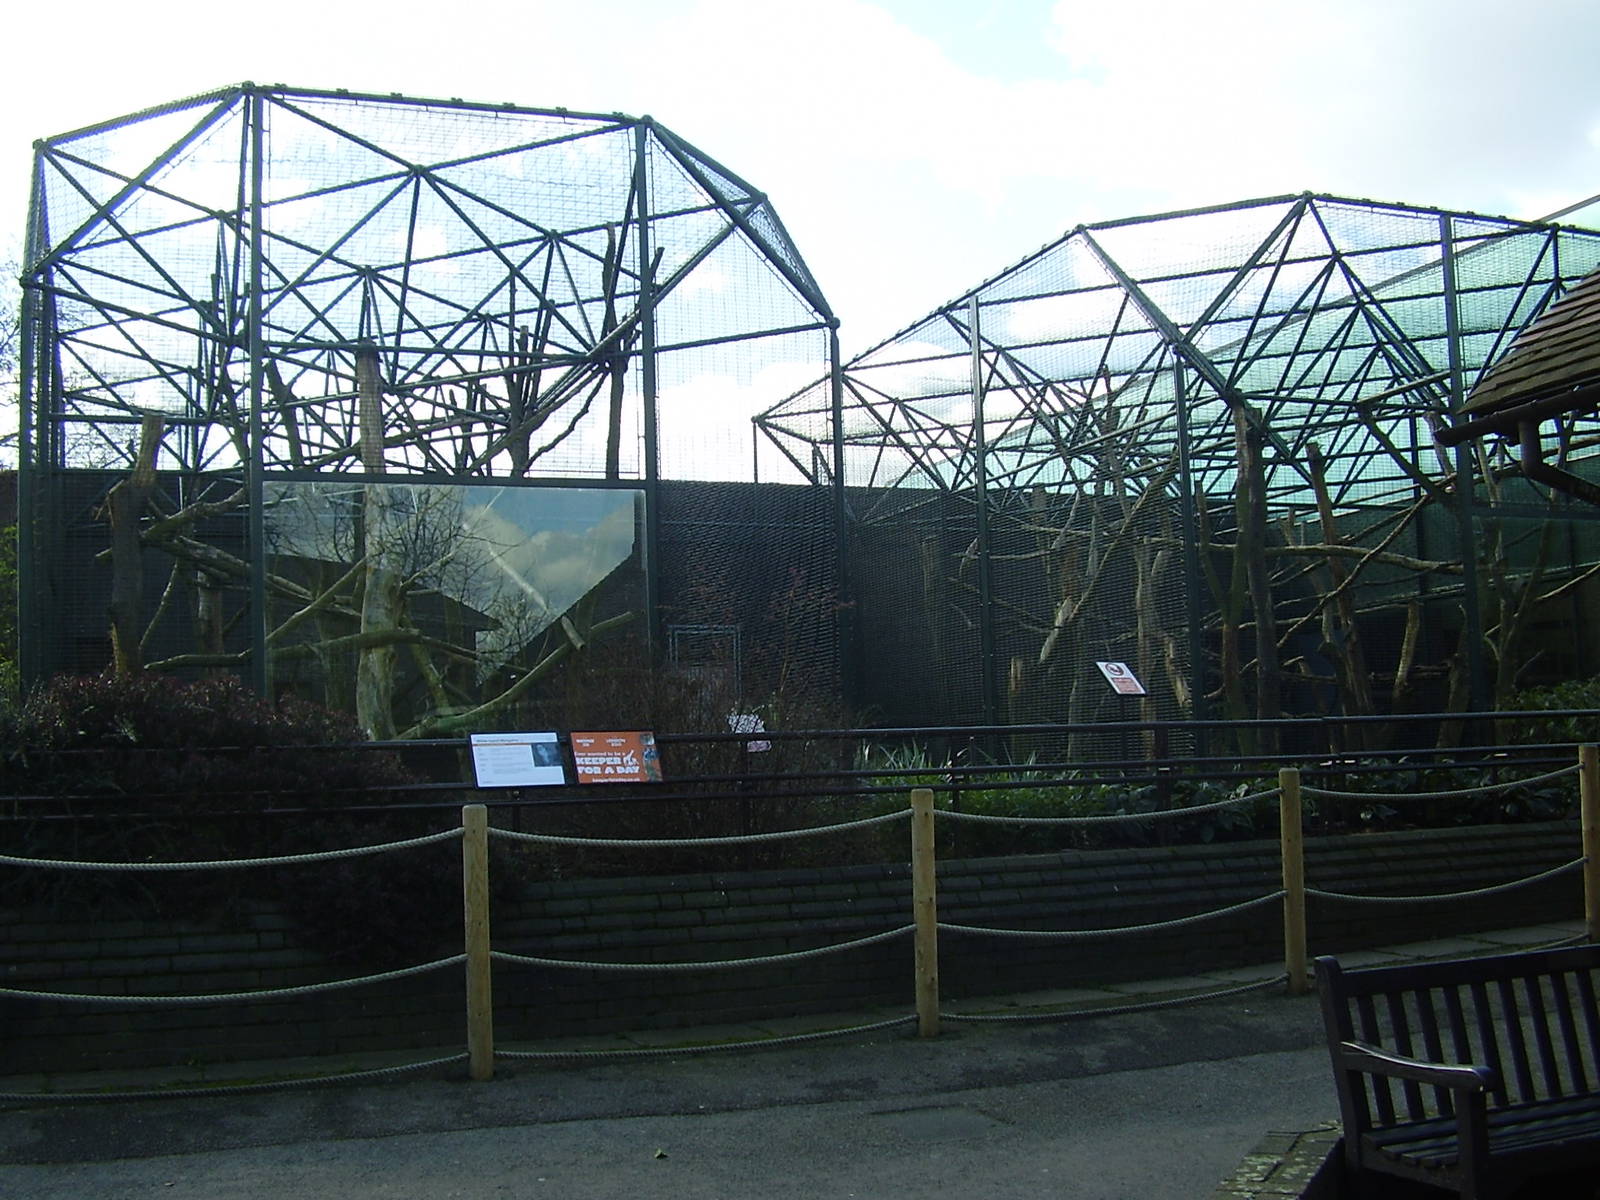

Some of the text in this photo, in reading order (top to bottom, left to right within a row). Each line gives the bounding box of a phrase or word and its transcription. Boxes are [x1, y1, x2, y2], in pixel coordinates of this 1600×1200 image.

[575, 757, 622, 765] KEEPER
[577, 766, 602, 774] FOR
[604, 766, 615, 774] A
